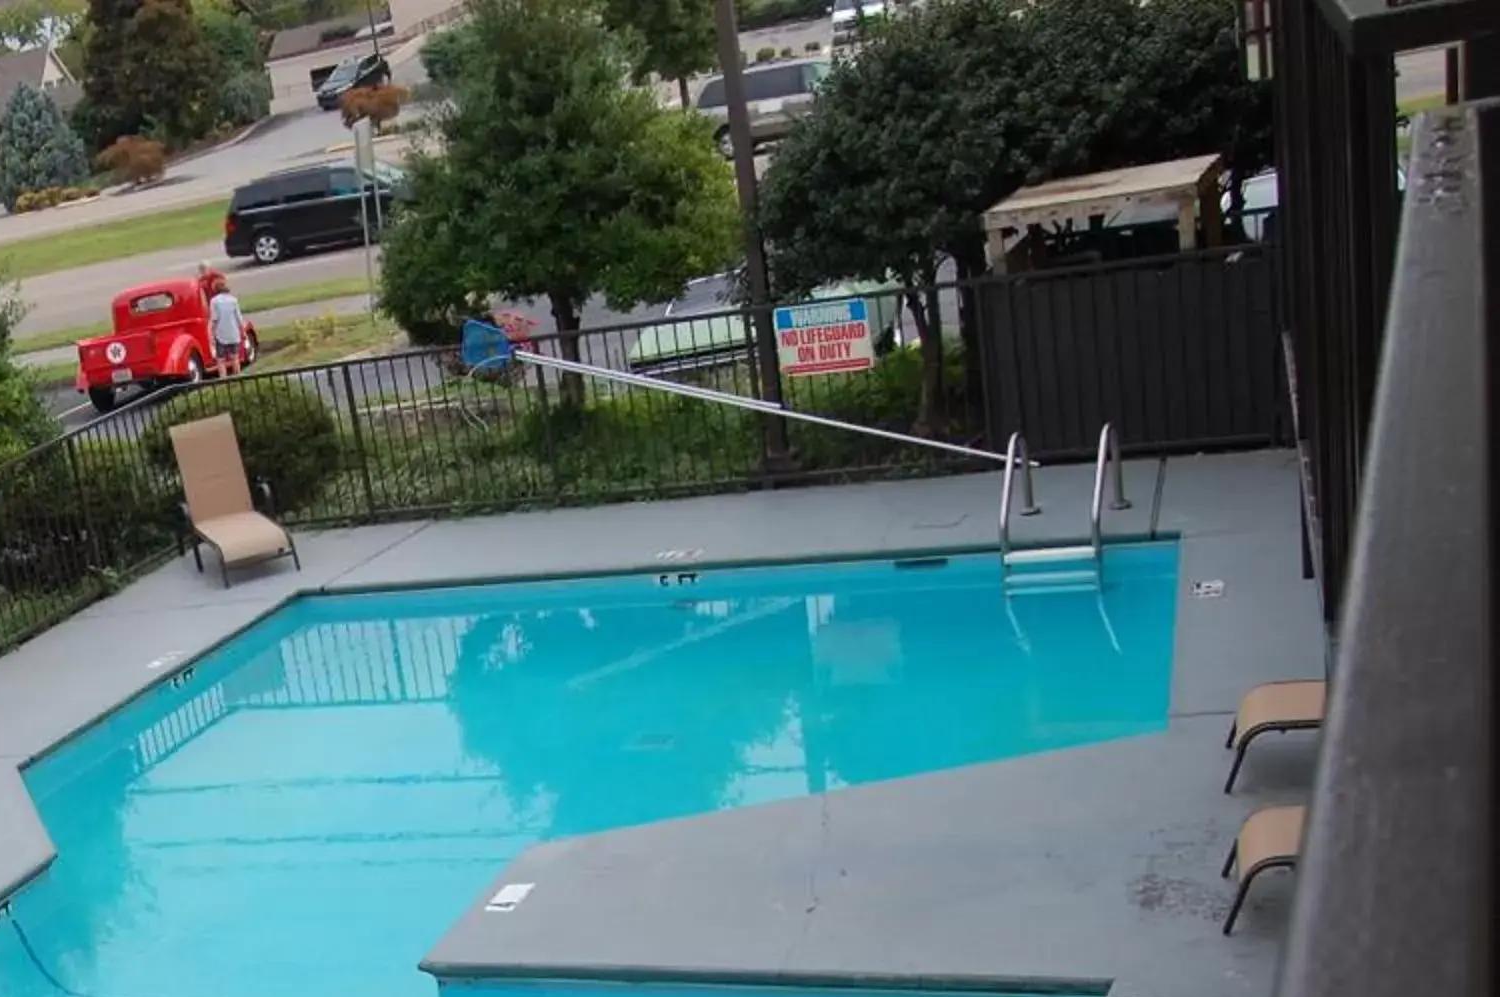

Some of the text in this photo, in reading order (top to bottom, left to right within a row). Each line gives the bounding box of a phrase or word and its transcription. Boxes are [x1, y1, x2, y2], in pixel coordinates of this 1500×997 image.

[781, 322, 865, 346] NO LIFEGUARD
[798, 342, 851, 361] ON DUTY
